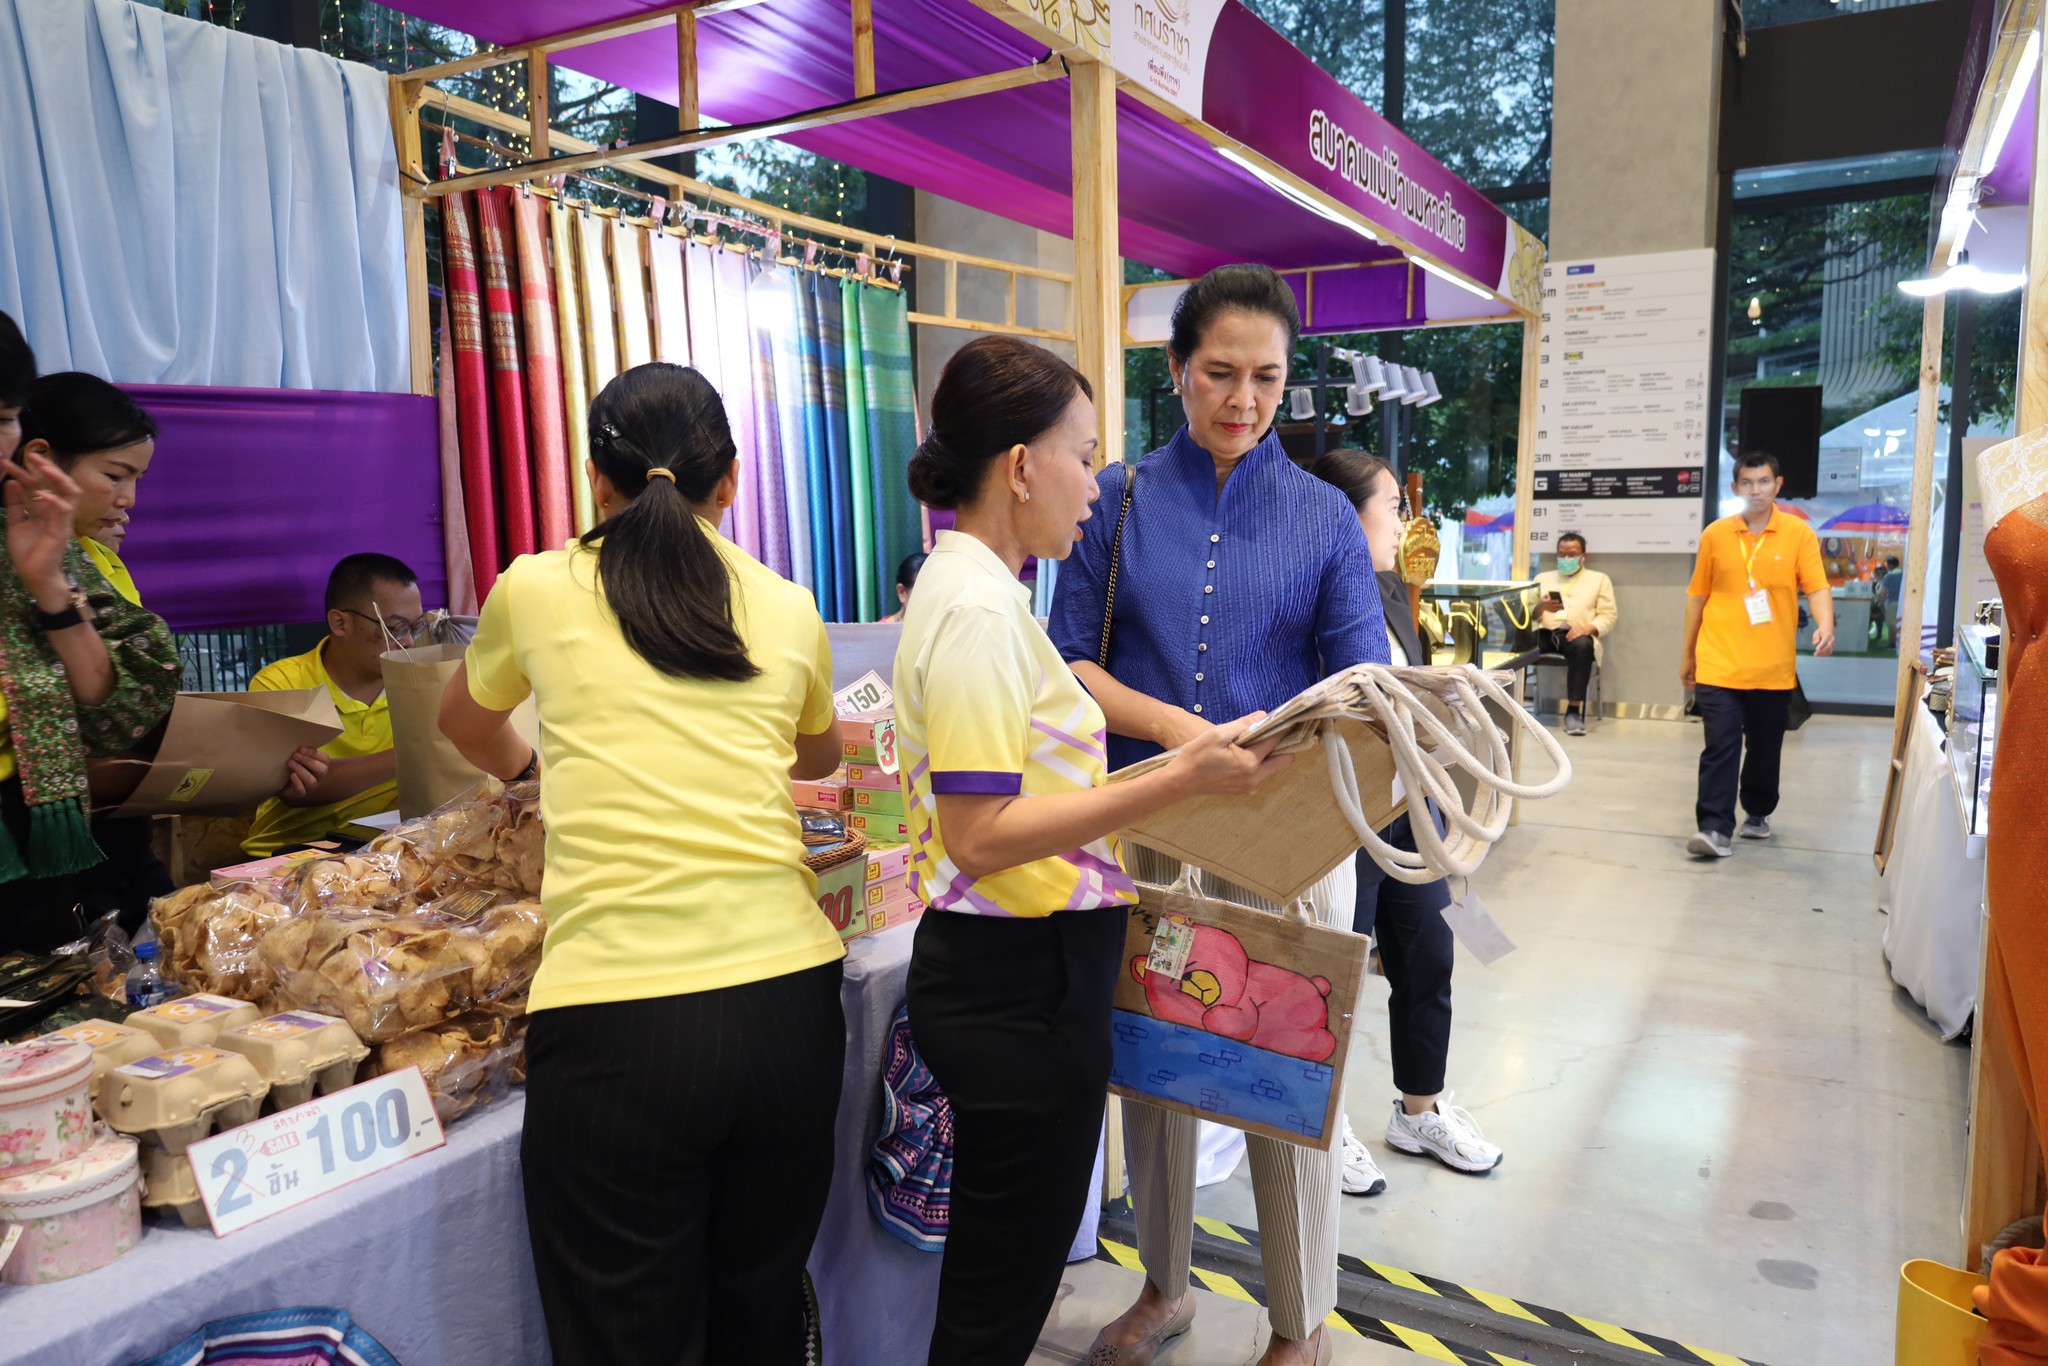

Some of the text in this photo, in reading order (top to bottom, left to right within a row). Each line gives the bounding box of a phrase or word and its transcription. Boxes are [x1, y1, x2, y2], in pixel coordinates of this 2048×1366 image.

[1134, 2, 1190, 61] ทศมราชา
[1310, 110, 1466, 252] สมาคมแม่บ้านมหาดไทย
[1541, 335, 1550, 343] 4
[1541, 354, 1550, 364] 3
[1540, 379, 1549, 388] 2
[1541, 405, 1546, 413] 1
[1534, 477, 1548, 491] G
[880, 730, 896, 767] 3
[267, 1132, 299, 1155] SALE
[306, 1088, 434, 1175] 100.-
[210, 1148, 253, 1218] 2
[265, 1162, 300, 1196] ชิ้น
